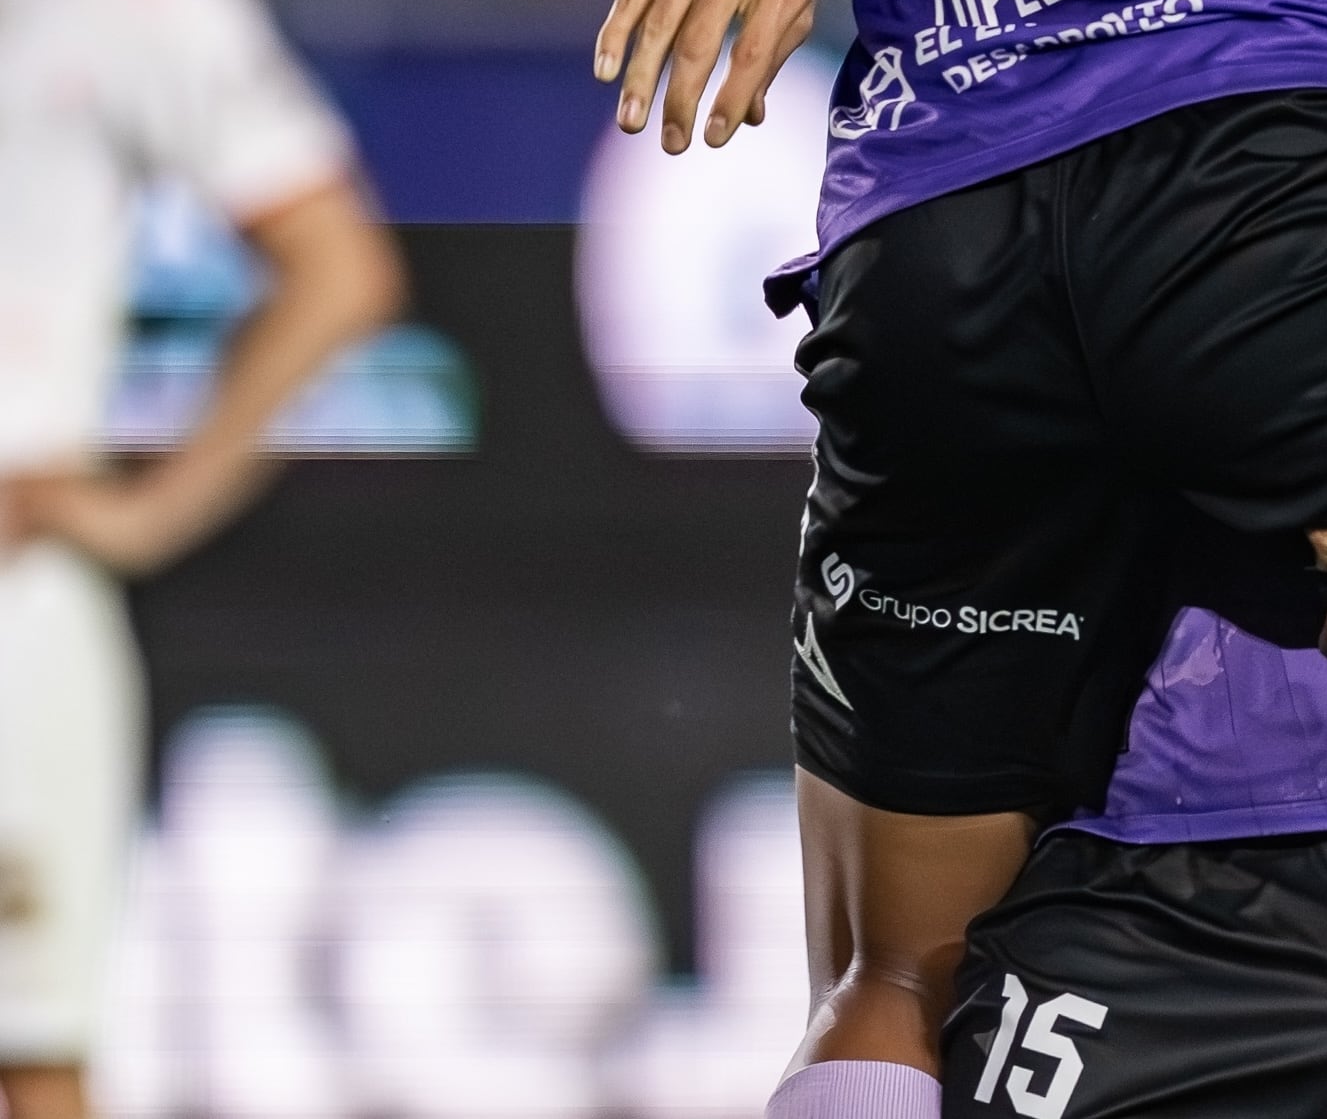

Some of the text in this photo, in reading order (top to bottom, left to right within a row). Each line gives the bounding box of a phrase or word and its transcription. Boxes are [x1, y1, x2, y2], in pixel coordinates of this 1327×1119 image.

[914, 26, 963, 66] EL
[858, 588, 1081, 640] Grupo SICREA
[974, 974, 1110, 1119] 15
